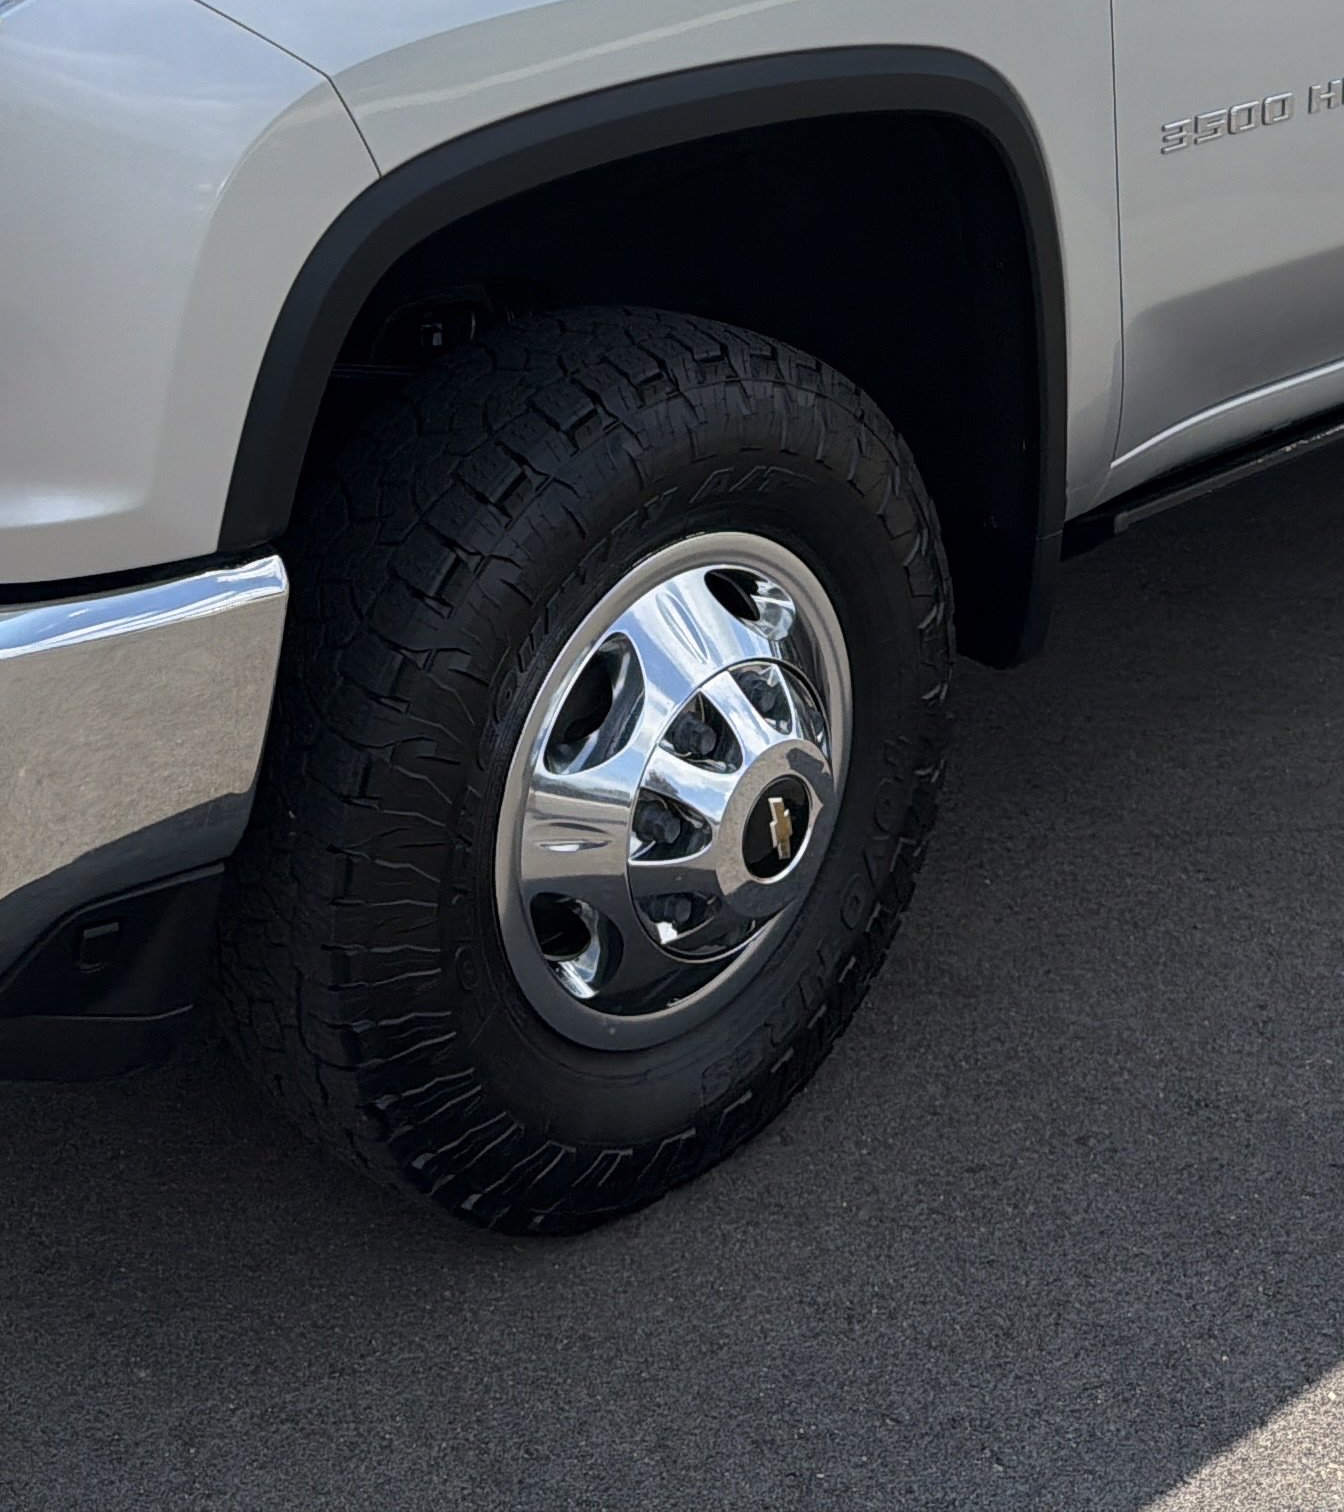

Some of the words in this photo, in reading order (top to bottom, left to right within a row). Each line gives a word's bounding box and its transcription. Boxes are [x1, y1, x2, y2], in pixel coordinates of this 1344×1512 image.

[1160, 92, 1295, 155] 3500
[477, 486, 680, 771] COUNTRY
[688, 464, 816, 504] A/T
[839, 733, 908, 931] TOYO
[700, 935, 843, 1108] TIRES
